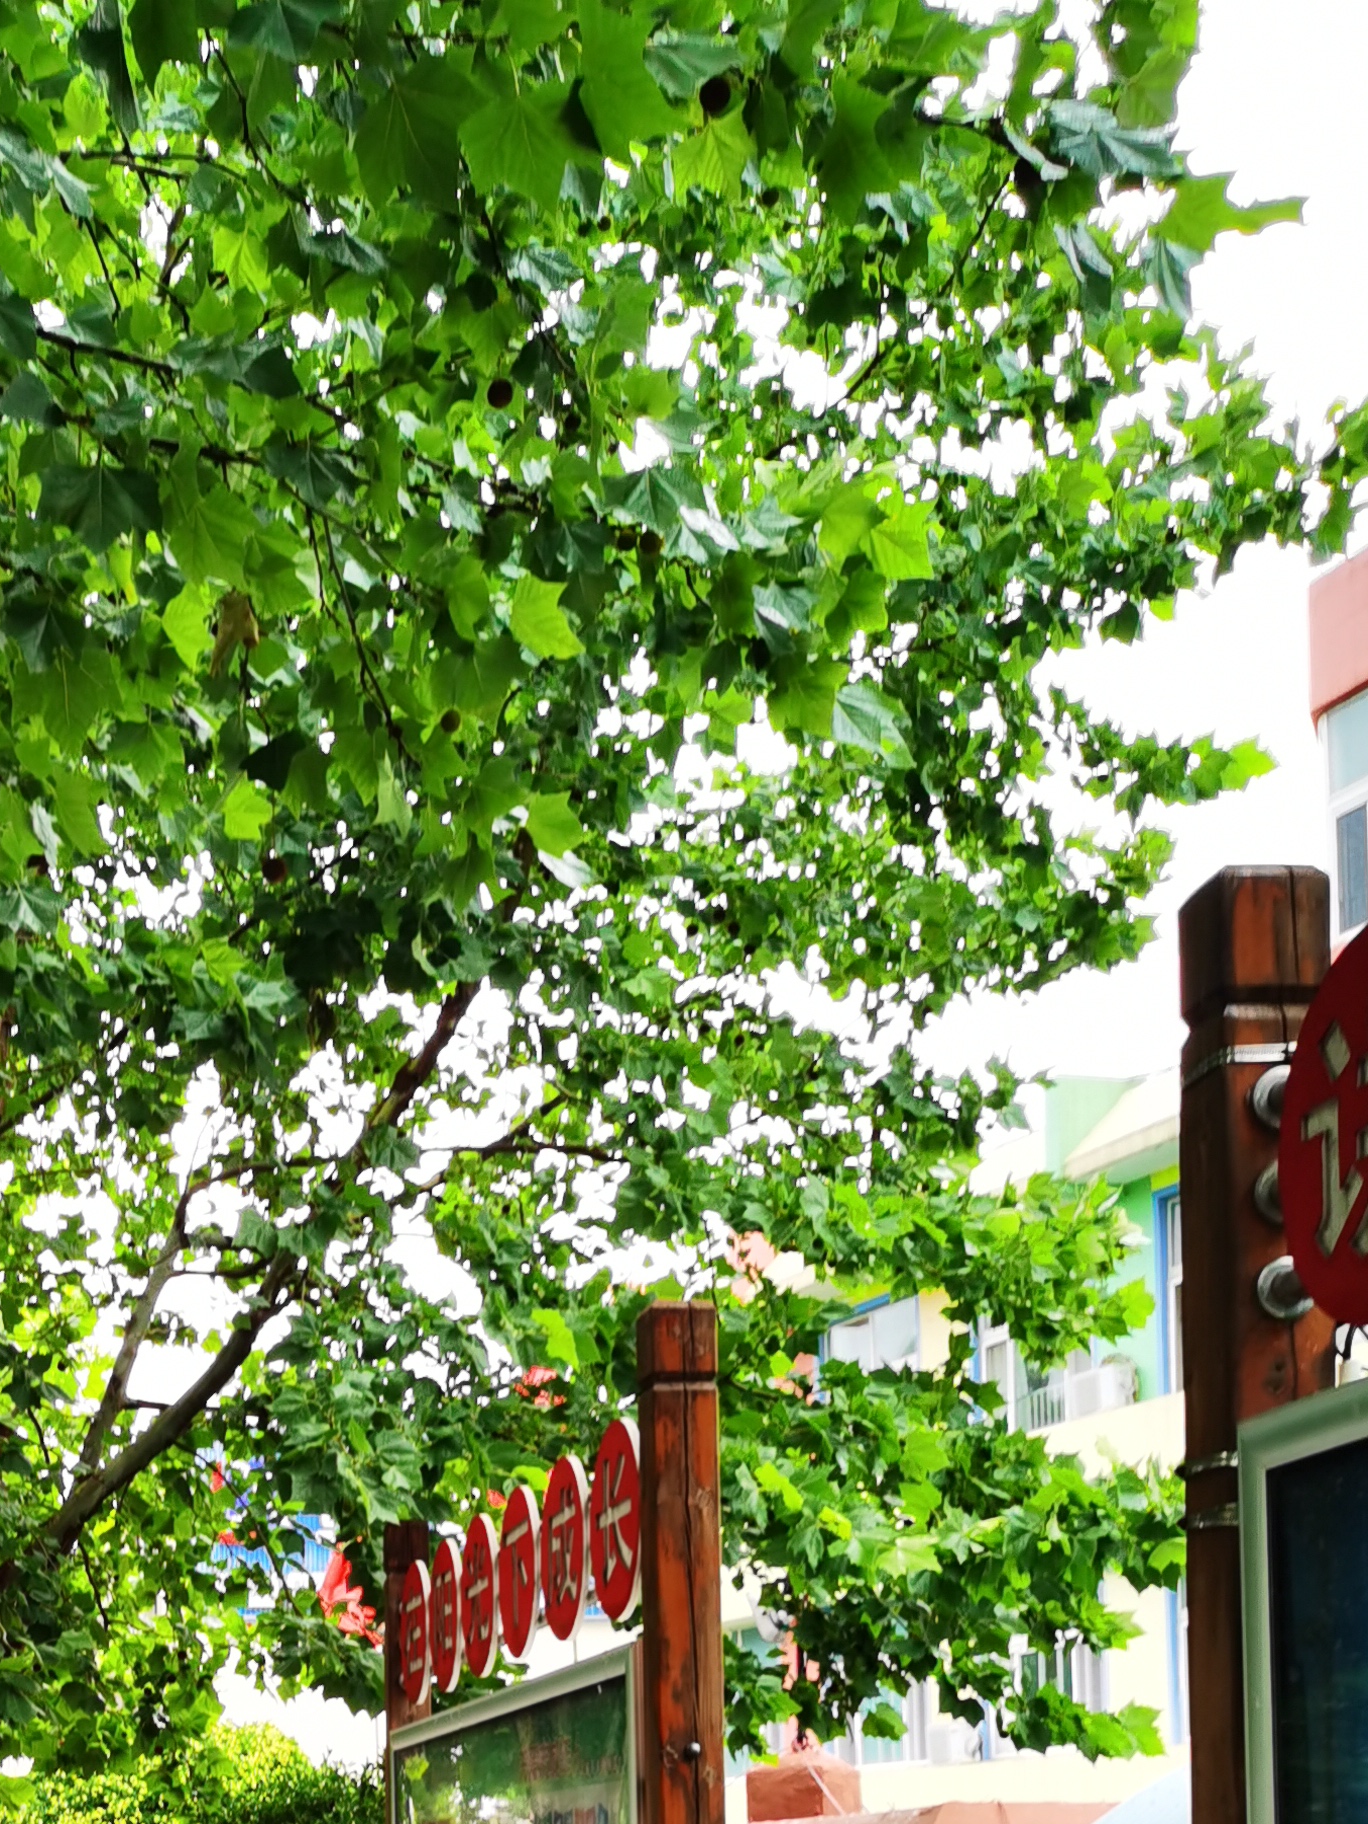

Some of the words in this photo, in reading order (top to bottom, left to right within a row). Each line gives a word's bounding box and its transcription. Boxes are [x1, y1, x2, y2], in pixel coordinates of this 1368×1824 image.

[403, 1453, 633, 1675] 在阳光下成长
